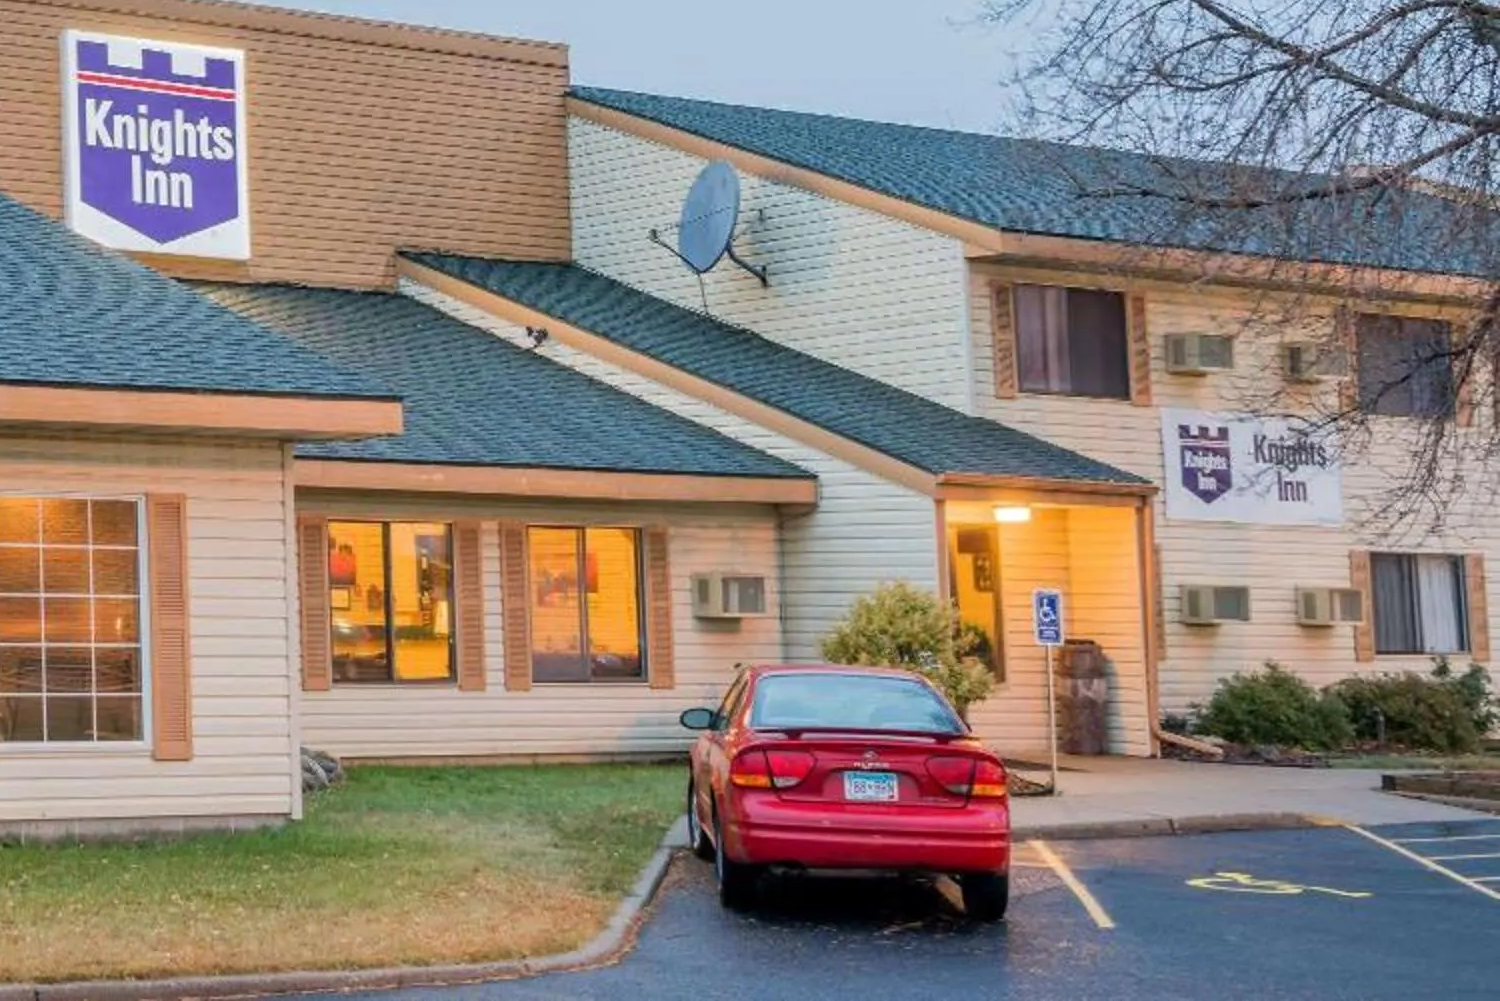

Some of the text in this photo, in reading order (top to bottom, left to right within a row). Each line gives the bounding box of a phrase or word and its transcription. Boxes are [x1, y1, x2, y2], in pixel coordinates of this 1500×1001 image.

[85, 98, 234, 165] Knights
[131, 155, 193, 208] Inn
[1183, 449, 1228, 473] Knights
[1253, 434, 1328, 473] Knights
[1197, 471, 1217, 491] Inn
[1277, 471, 1308, 503] Inn
